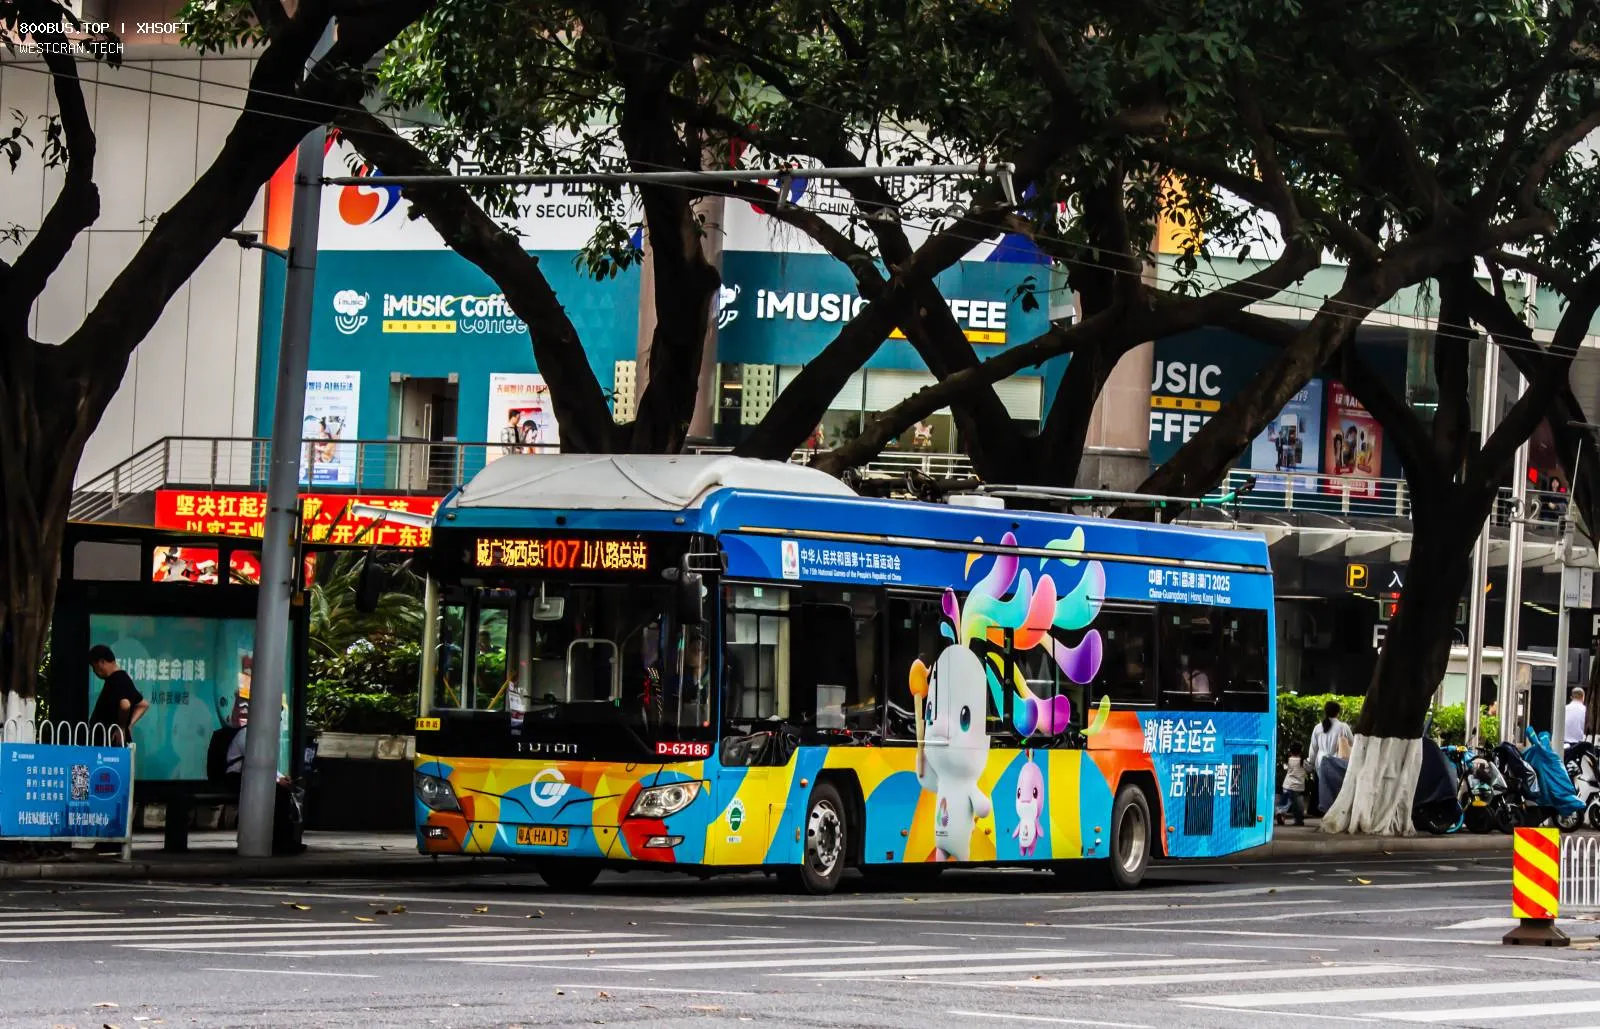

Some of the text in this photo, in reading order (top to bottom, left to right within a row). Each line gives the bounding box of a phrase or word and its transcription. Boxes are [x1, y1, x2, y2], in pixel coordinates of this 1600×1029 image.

[819, 202, 859, 213] CHINA
[383, 293, 515, 317] iMUSIC Coffe
[756, 288, 1007, 330] iMUSIC FEE
[1151, 360, 1222, 396] USIC
[1148, 411, 1213, 443] FFE
[544, 540, 580, 568] 107
[800, 548, 901, 571] 中华人民共和国第十五届运动会
[818, 568, 833, 577] National
[833, 569, 846, 577] Games
[892, 573, 902, 581] China
[1212, 574, 1230, 591] 2025
[1349, 565, 1365, 587] P
[1143, 718, 1217, 753] 激情全运会
[658, 742, 708, 756] D-62186
[1169, 763, 1241, 797] 活力大湾区
